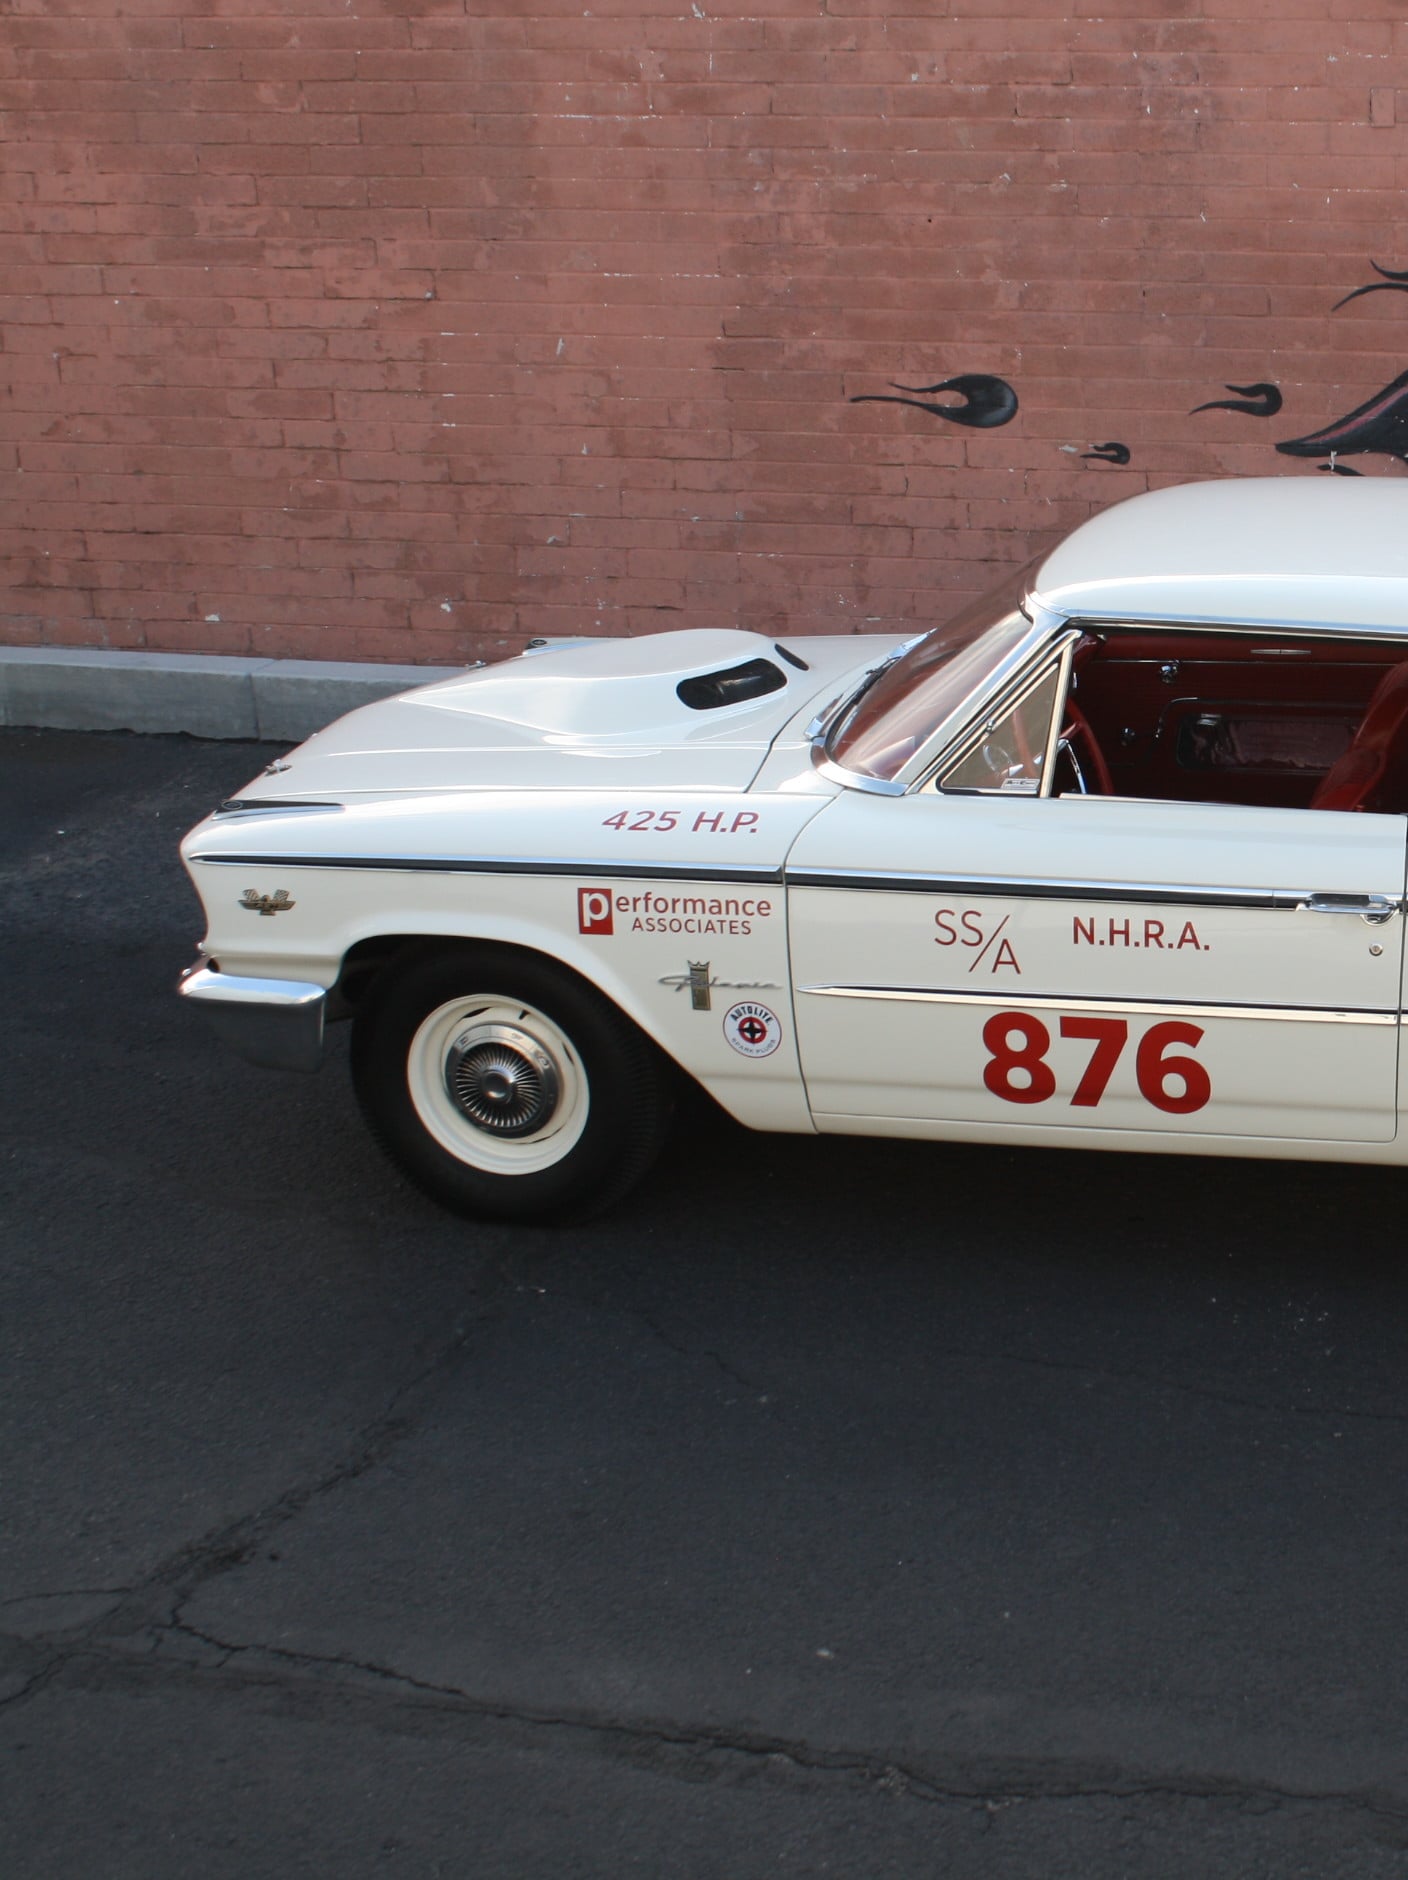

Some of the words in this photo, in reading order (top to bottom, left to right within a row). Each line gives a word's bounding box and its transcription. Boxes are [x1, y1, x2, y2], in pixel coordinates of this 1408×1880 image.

[602, 810, 681, 831] 425
[691, 811, 760, 833] H.P.
[579, 889, 772, 928] performance
[632, 917, 752, 935] ASSOCIATES
[1072, 916, 1211, 951] N.H.R.A.
[730, 1005, 774, 1024] AUTOLITE
[982, 1011, 1211, 1114] 876
